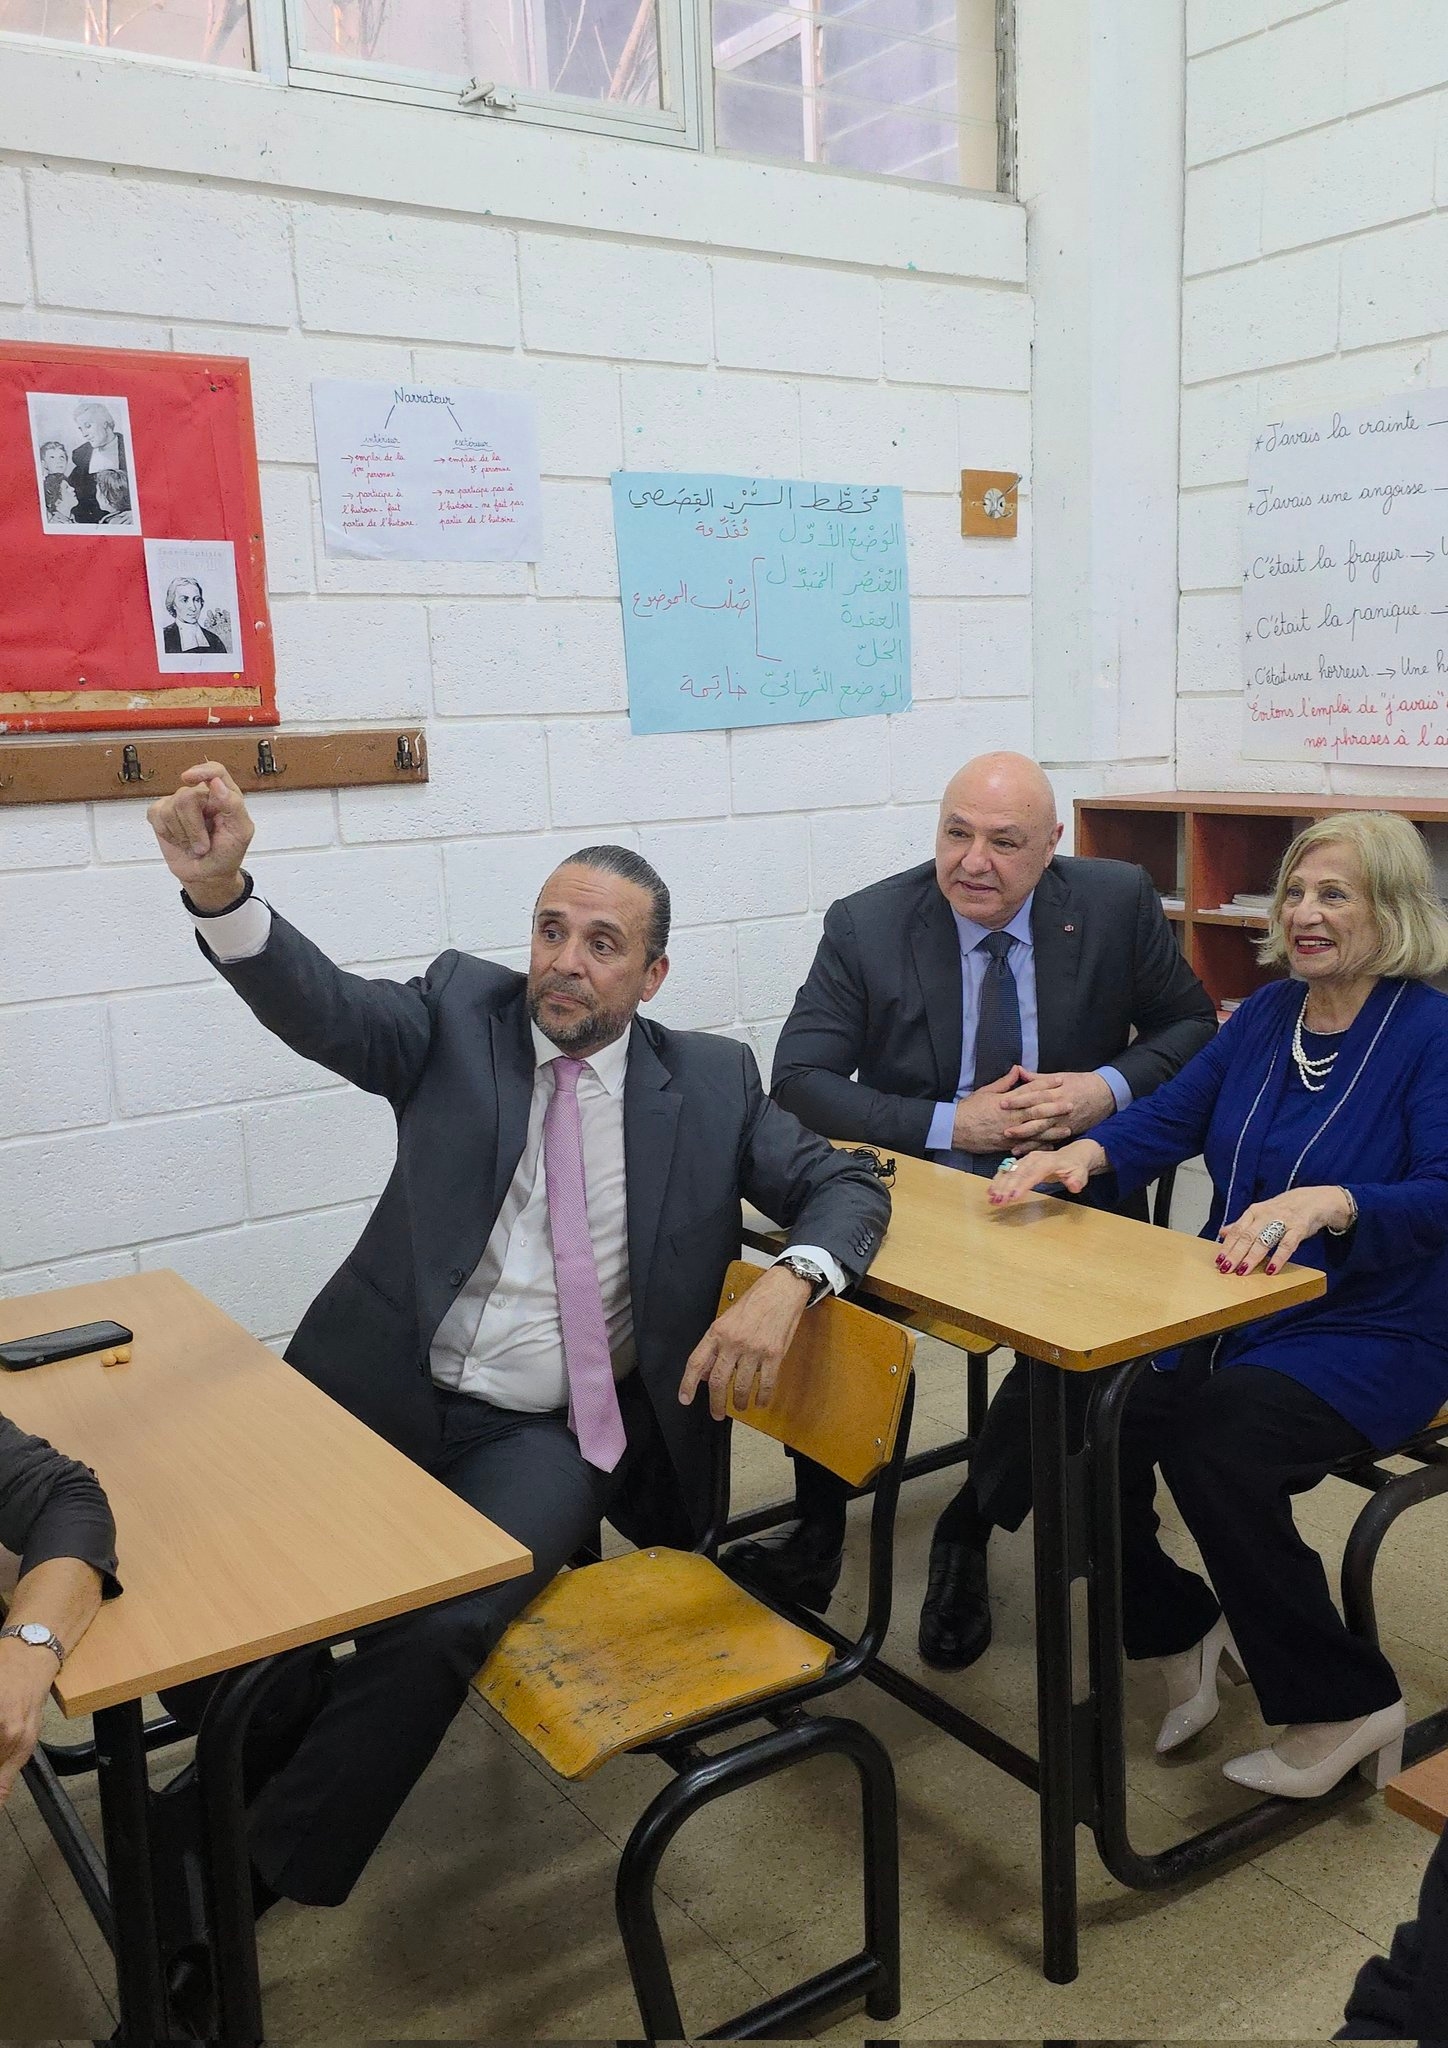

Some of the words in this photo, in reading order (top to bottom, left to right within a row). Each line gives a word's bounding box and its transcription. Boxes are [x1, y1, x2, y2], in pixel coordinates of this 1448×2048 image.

[394, 387, 455, 405] Narrateur
[1327, 412, 1351, 439] la
[1358, 410, 1420, 435] crainte
[354, 452, 382, 467] emploi
[384, 452, 393, 461] de
[395, 452, 405, 462] la
[448, 454, 476, 467] emploi
[479, 454, 489, 462] de
[491, 452, 501, 461] la
[1255, 485, 1312, 516] J'avais
[1317, 493, 1352, 505] une
[367, 518, 377, 527] de
[467, 515, 476, 524] de
[1309, 544, 1337, 572] la
[1256, 608, 1312, 639] C'était
[1317, 603, 1344, 629] la
[1400, 655, 1430, 676] Une
[1247, 694, 1295, 722] Évitons
[1296, 693, 1353, 726] l'emploi
[1355, 694, 1378, 715] de
[1303, 735, 1328, 748] nos
[1331, 727, 1391, 761] phrases
[1393, 729, 1410, 747] à
